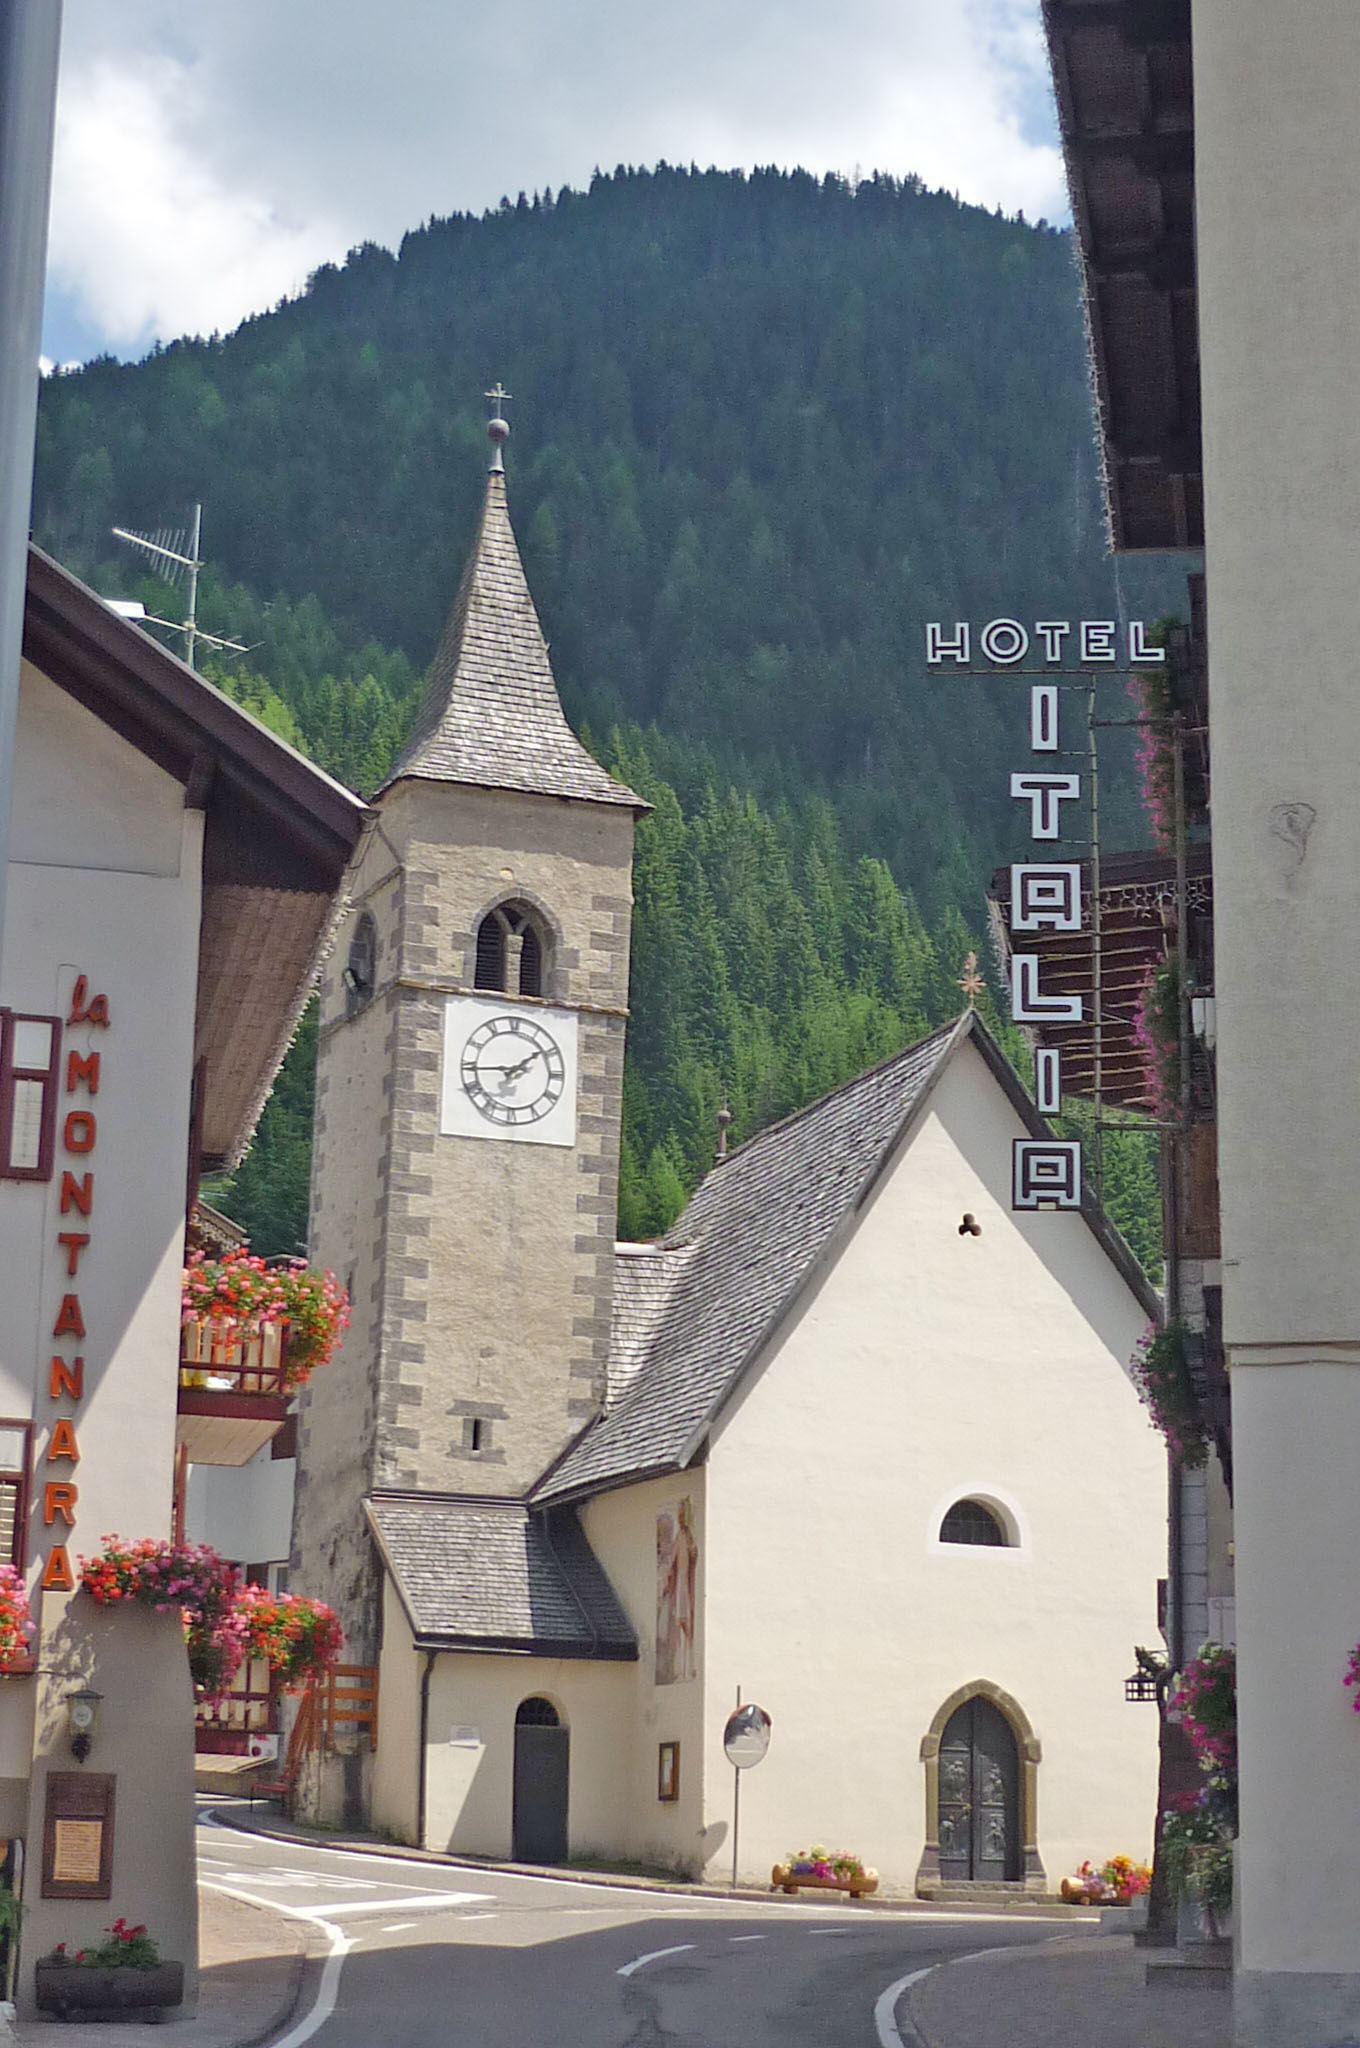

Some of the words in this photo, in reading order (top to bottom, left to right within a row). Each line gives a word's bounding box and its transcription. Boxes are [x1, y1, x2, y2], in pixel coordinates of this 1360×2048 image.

[926, 618, 1165, 664] HOTEL
[65, 974, 111, 1028] la
[1010, 686, 1082, 1210] ITALIA
[41, 1050, 100, 1591] MONTANARA
